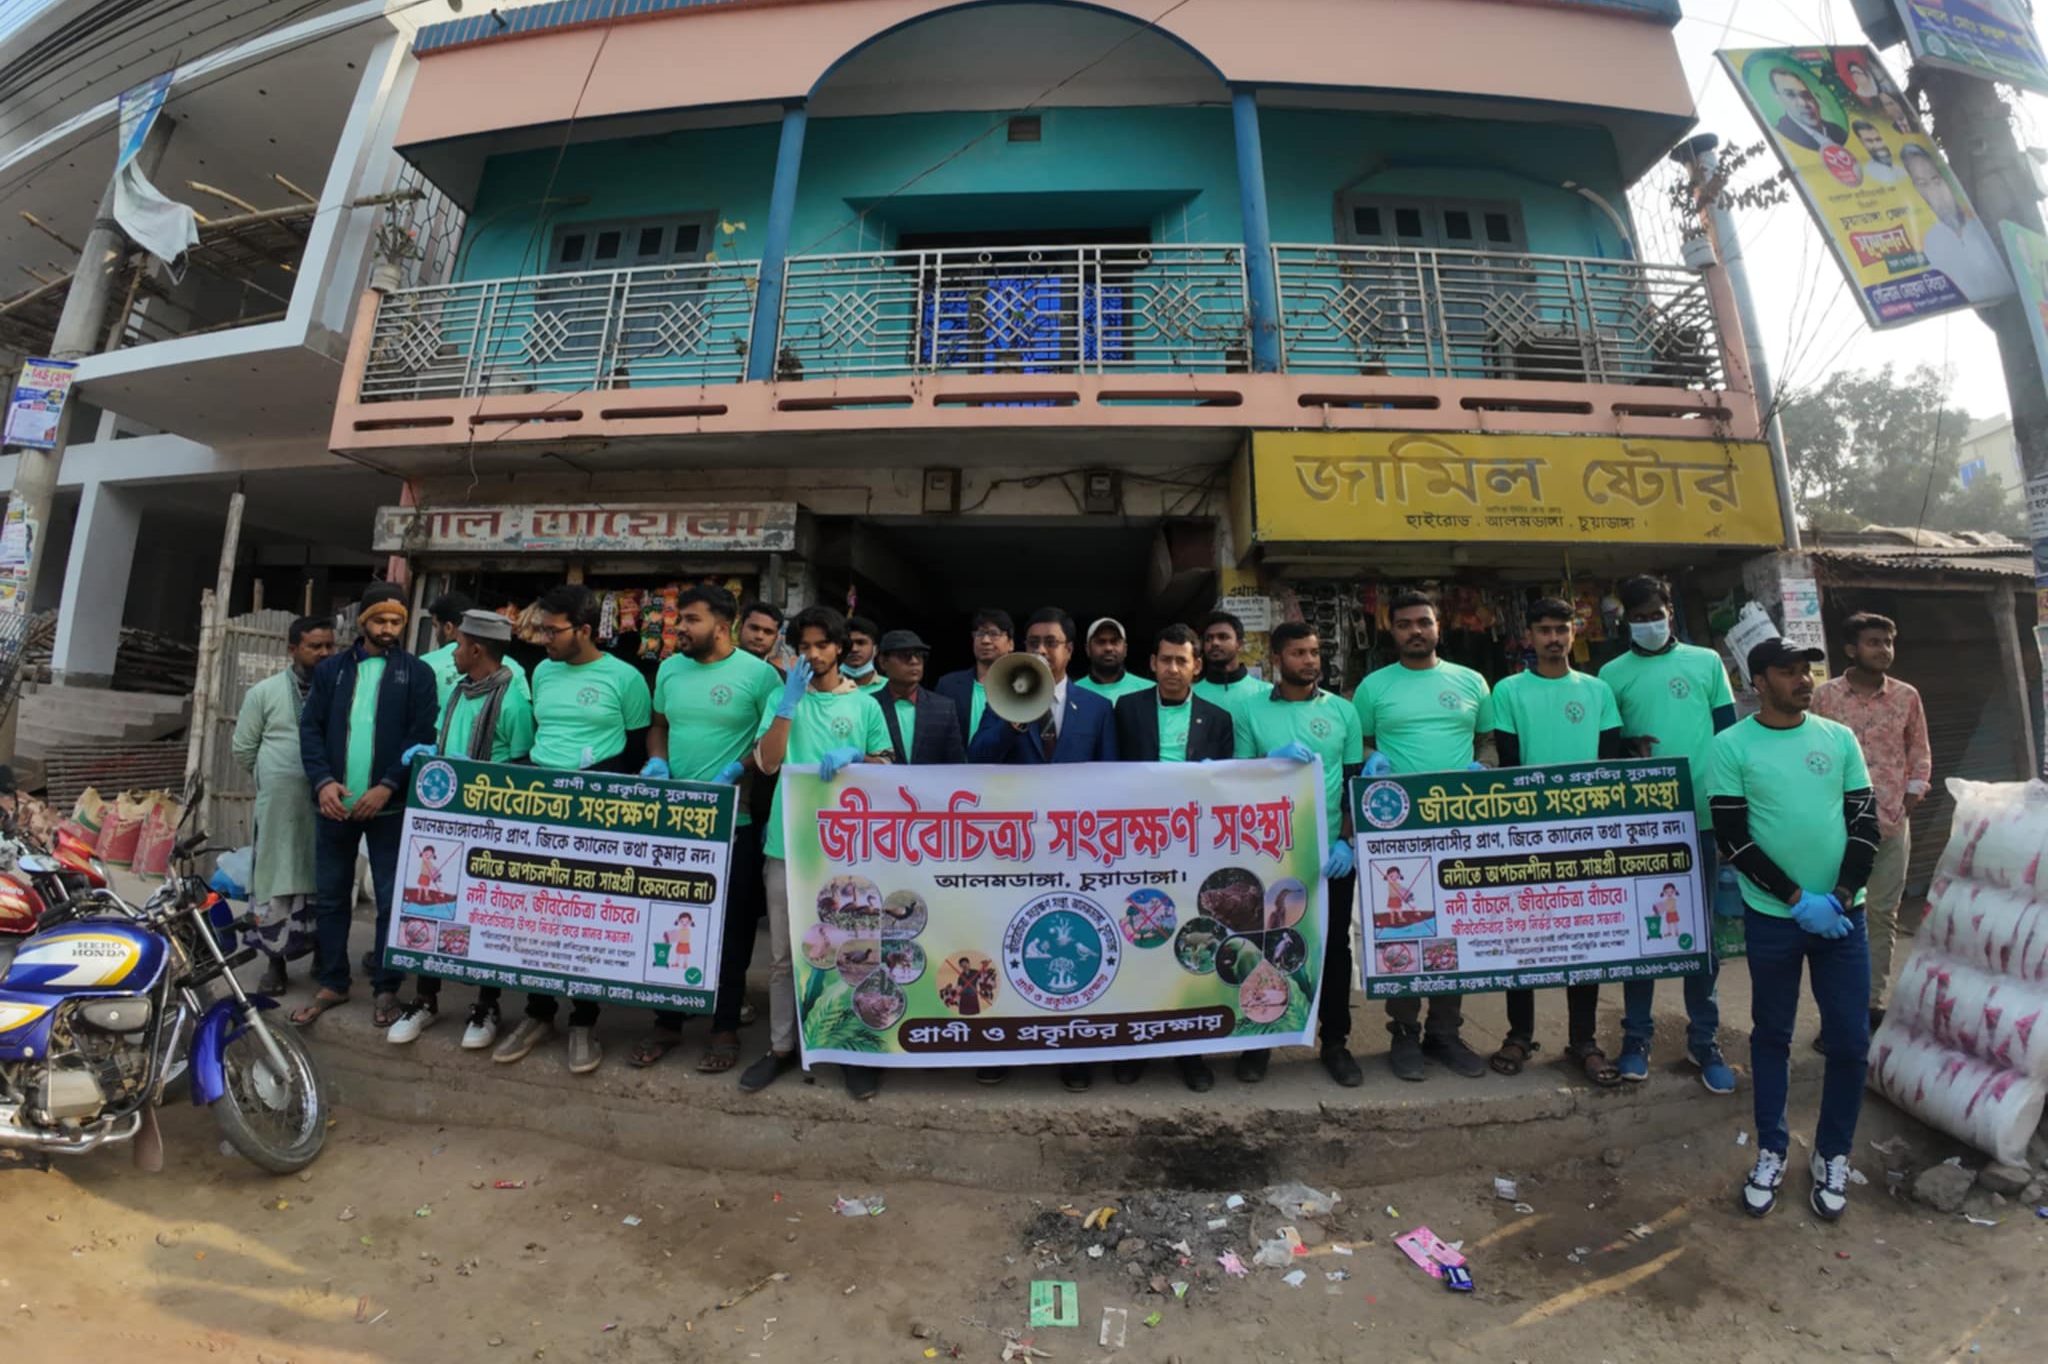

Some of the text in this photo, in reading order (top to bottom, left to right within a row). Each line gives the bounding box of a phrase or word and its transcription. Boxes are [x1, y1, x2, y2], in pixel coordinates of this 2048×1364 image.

[1293, 434, 1740, 513] জামিল ষ্টোর
[553, 777, 719, 805] প্রাণী ও প্রকৃতির সুরক্ষায়
[1513, 766, 1677, 787] প্রাণী ও প্রকৃতির সুরক্ষায়
[463, 774, 572, 818] জীববৈচিত্র্য
[579, 792, 661, 829] সংরক্ষণ
[667, 803, 718, 838] সংস্থা
[1418, 782, 1538, 824] জীববৈচিত্র্য
[1545, 787, 1626, 816] সংরক্ষণ
[1634, 779, 1680, 813] সংস্থা
[411, 814, 502, 843] আলমডাঙ্গাবাসীর
[536, 827, 569, 850] জিকে
[573, 836, 619, 856] ক্যানেল
[623, 842, 646, 859] তথা
[651, 843, 687, 867] কুমার
[816, 786, 1036, 865] জীববৈচিত্র্য
[1047, 801, 1200, 867] সংরক্ষণ
[1212, 796, 1295, 860] সংস্থা
[1366, 831, 1471, 856] আলমডাঙ্গাবাসীর
[1507, 825, 1543, 849] জিকে
[1547, 826, 1595, 845] ক্যানেল
[1597, 823, 1622, 842] তথা
[1625, 822, 1661, 846] কুমার
[470, 854, 504, 878] নদীতে
[508, 857, 570, 884] অপচনশীল
[573, 868, 596, 889] দ্রব্য
[599, 866, 634, 892] সামগ্রী
[637, 877, 689, 899] ফেলবেন
[1079, 869, 1188, 893] চুয়াডাঙ্গা।
[1443, 862, 1482, 887] নদীতে
[1485, 857, 1552, 884] অপচনশীল
[1554, 860, 1578, 879] দ্রব্য
[1581, 850, 1617, 878] সামগ্রী
[1620, 852, 1669, 874] ফেলবেন
[466, 884, 488, 908] নদী
[1445, 892, 1469, 917] নদী
[1517, 885, 1585, 913] জীববৈচিত্র্য
[72, 949, 127, 957] HONDA
[907, 1013, 1224, 1048] প্রাণী ও প্রকৃতির সুরক্ষায়
